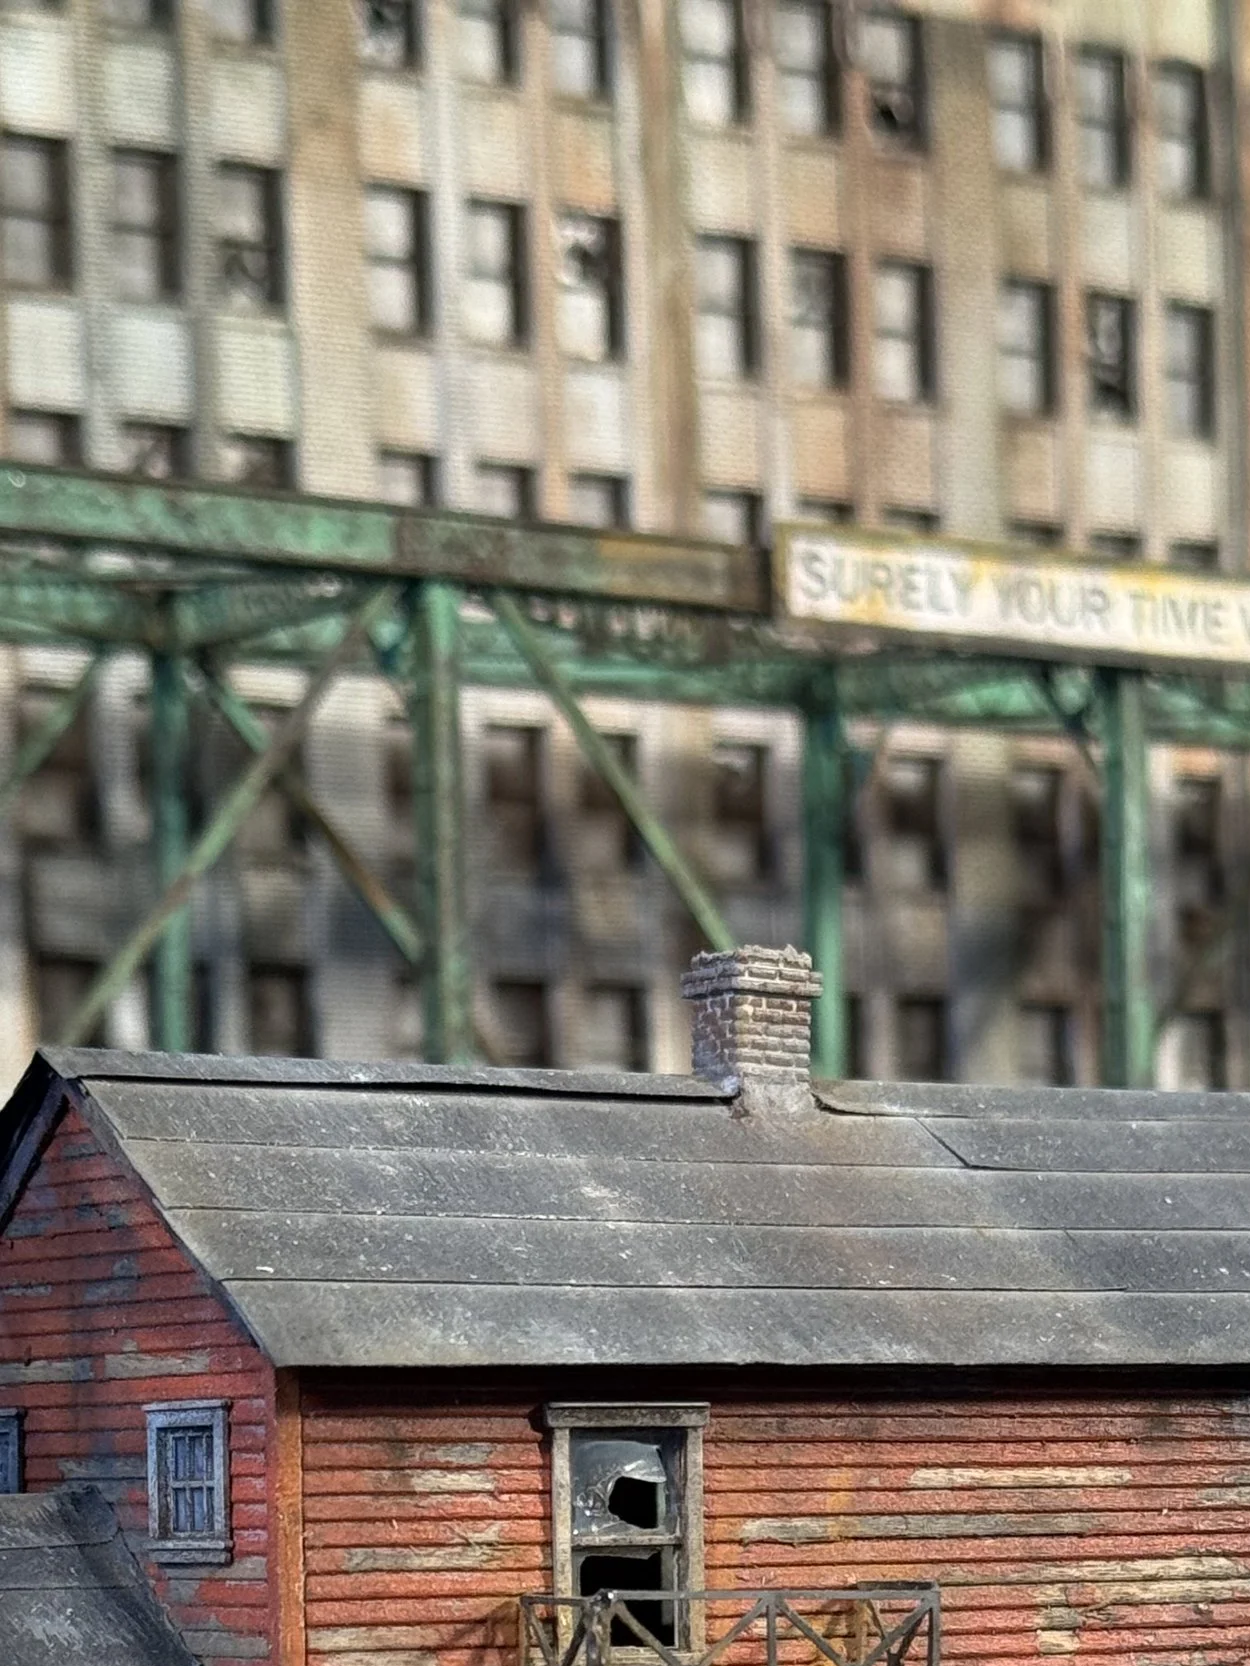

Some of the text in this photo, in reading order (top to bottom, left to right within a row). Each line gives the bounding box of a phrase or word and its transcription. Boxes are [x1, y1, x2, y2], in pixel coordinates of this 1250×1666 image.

[801, 550, 974, 618] SURELY
[992, 571, 1112, 633] YOUR
[1127, 586, 1235, 648] TIME
